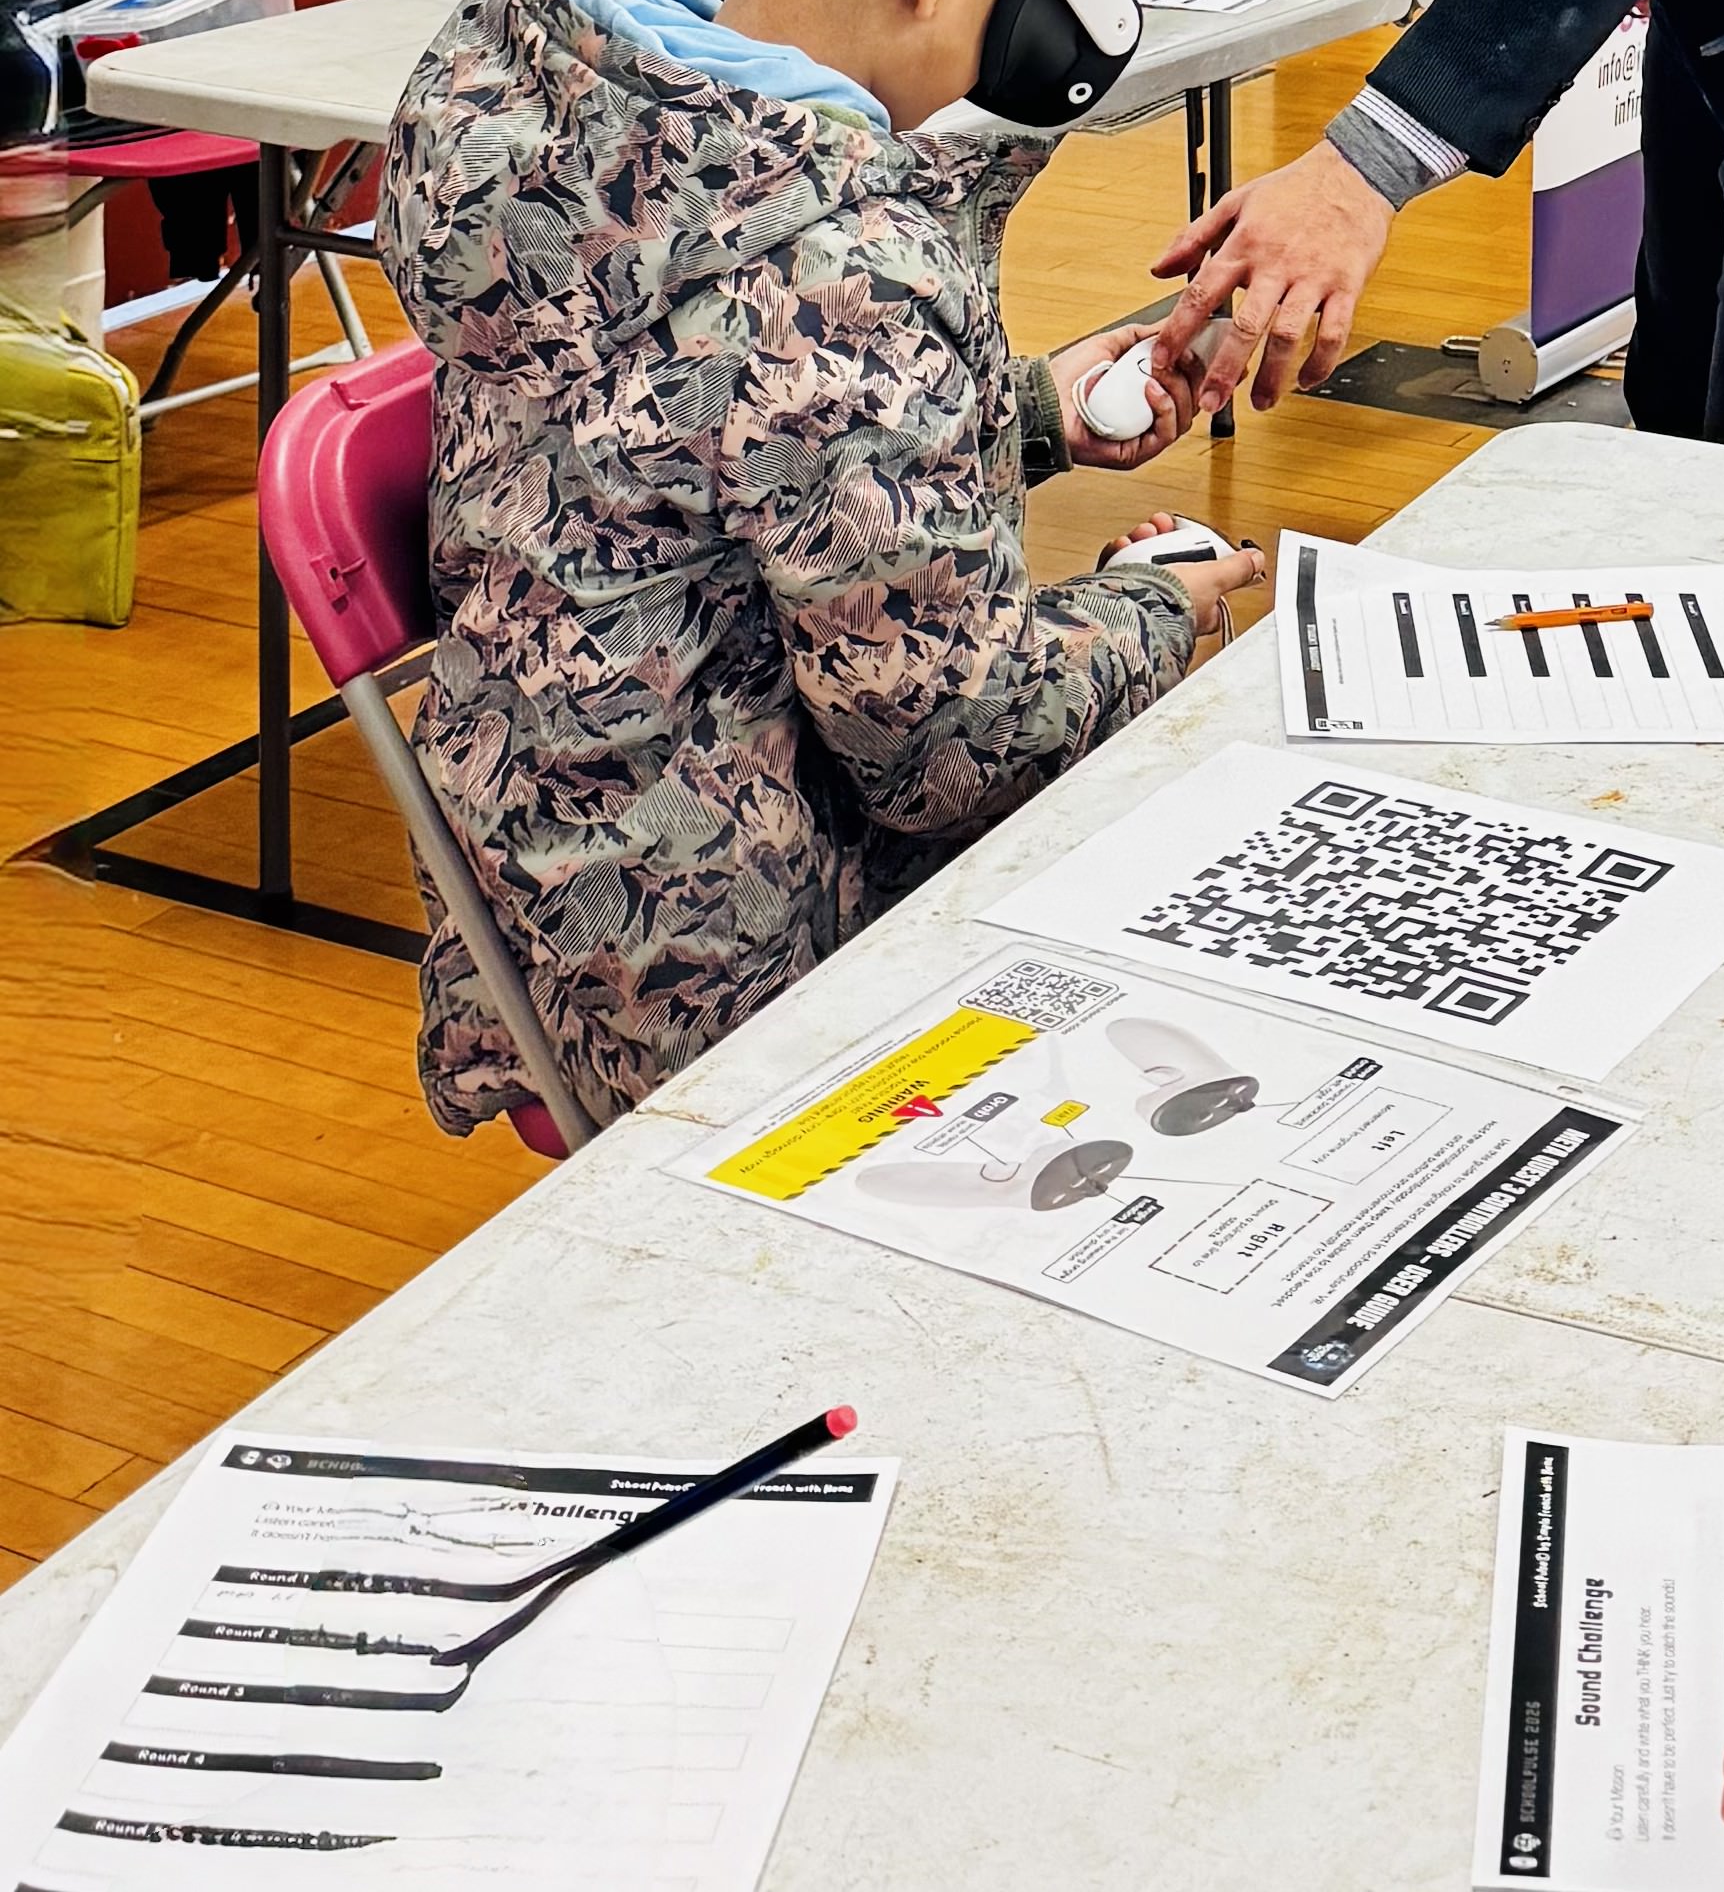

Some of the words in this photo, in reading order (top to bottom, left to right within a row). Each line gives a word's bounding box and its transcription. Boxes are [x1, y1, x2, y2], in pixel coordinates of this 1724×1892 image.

[858, 1081, 929, 1122] WARNING
[966, 1095, 1010, 1119] Grab
[1372, 1131, 1405, 1150] Left
[1542, 1128, 1590, 1157] META
[1510, 1155, 1559, 1187] QUEST
[1500, 1183, 1525, 1194] 3
[1237, 1224, 1285, 1257] Right
[1426, 1192, 1516, 1257] CONTROLLERS
[1382, 1264, 1432, 1296] USER
[1346, 1292, 1399, 1330] GUIDE
[250, 1570, 301, 1584] Round
[214, 1624, 264, 1639] Round
[269, 1628, 279, 1639] 2
[1578, 1579, 1613, 1663] Challenge
[179, 1681, 231, 1697] Round
[234, 1685, 245, 1697] 3
[1575, 1670, 1601, 1726] Sound
[1525, 1701, 1540, 1733] 2026
[138, 1748, 190, 1764] Round
[194, 1753, 206, 1765] 4
[1520, 1739, 1539, 1822] SCHOOLPULSE
[95, 1819, 148, 1836] Round
